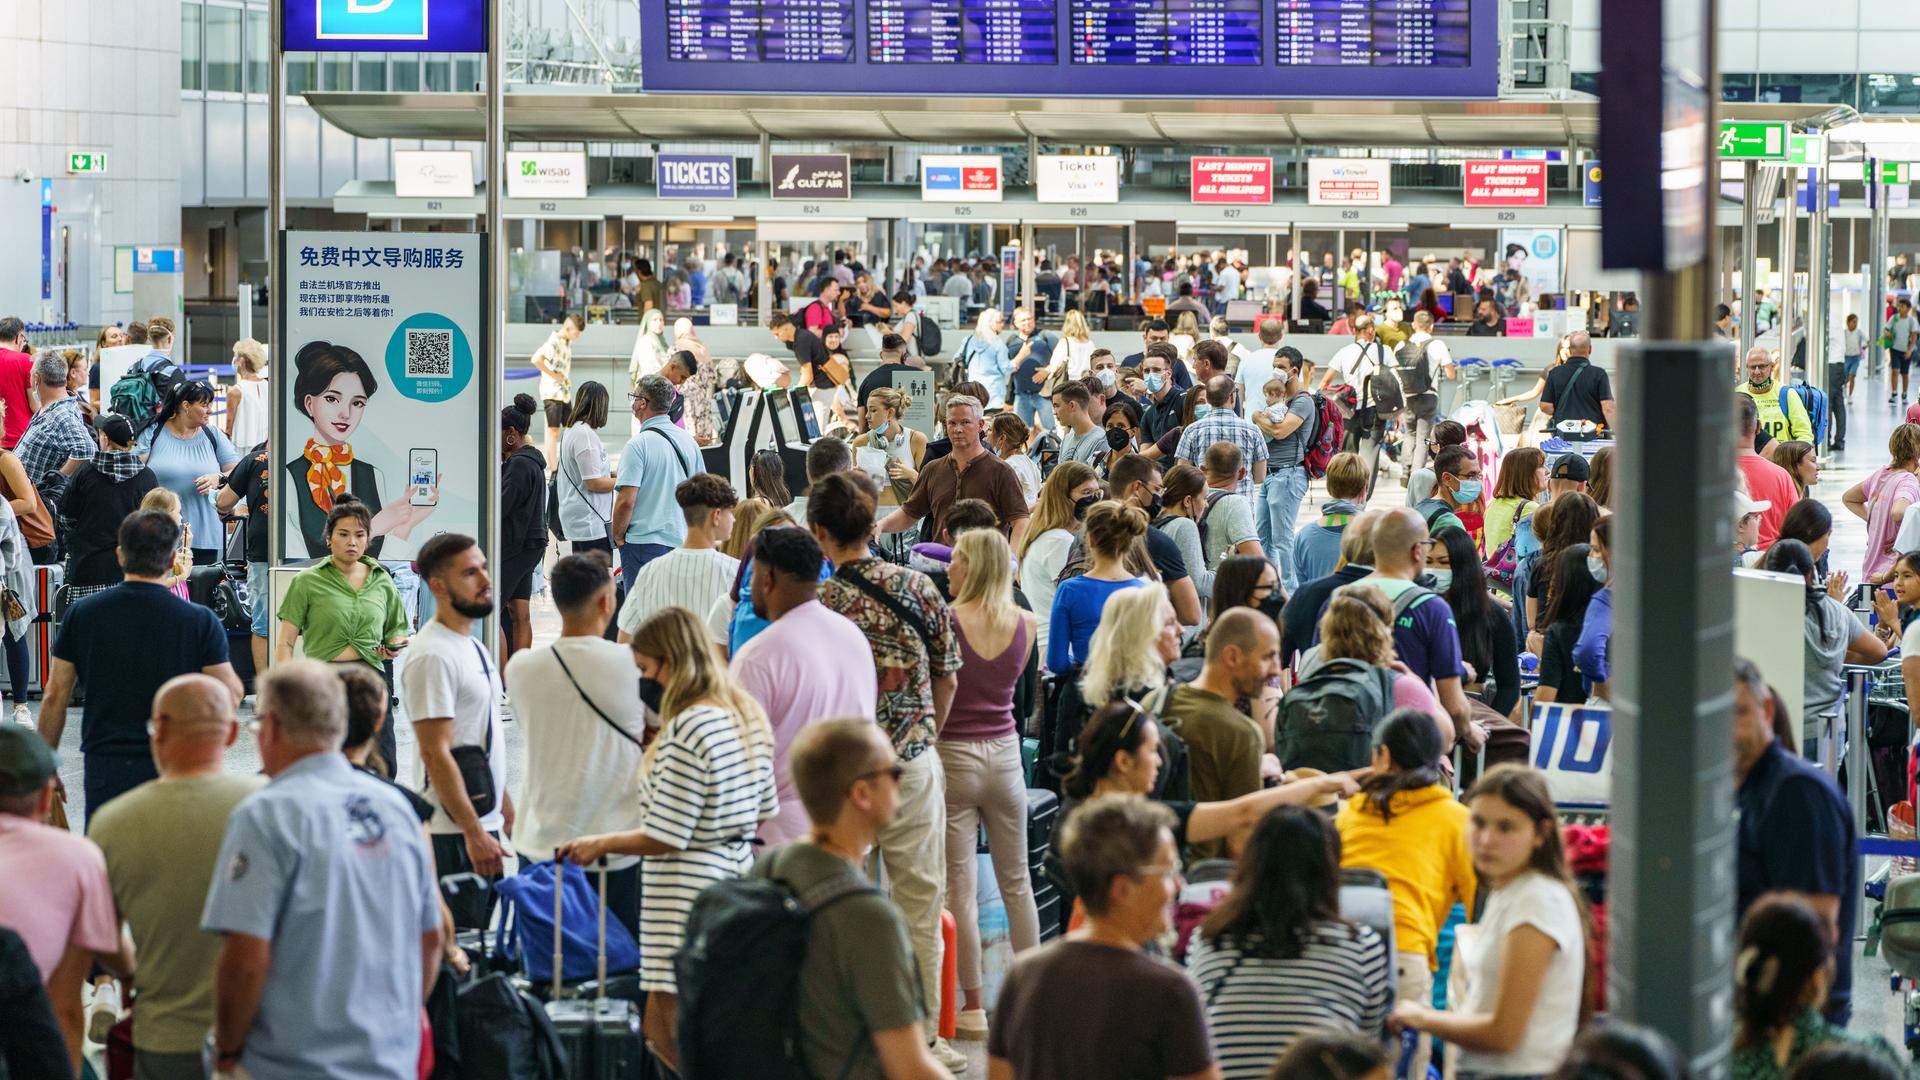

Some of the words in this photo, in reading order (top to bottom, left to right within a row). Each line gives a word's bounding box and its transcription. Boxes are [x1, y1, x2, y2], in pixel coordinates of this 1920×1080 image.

[1058, 161, 1096, 171] Ticket
[1197, 162, 1224, 171] LAST
[1224, 162, 1266, 172] MINUTE
[1471, 165, 1498, 174] LAST
[1497, 165, 1540, 174] MINUTE
[662, 161, 730, 184] TICKETS
[1211, 173, 1253, 183] TICKETS
[1484, 176, 1527, 185] TICKETS
[797, 179, 824, 188] GULF
[826, 179, 843, 188] AIR
[1198, 185, 1217, 194] ALL
[1218, 185, 1266, 195] AIRLINES
[1471, 188, 1490, 197] ALL
[1491, 188, 1540, 197] AIRLINES
[954, 206, 972, 215] 825
[1070, 207, 1087, 216] 826
[1224, 209, 1241, 217] 827
[1342, 210, 1359, 219] 828
[1497, 212, 1516, 220] 829
[299, 246, 465, 269] 免费中文导购服务
[299, 280, 381, 290] 由法兰机场官方推出
[299, 294, 390, 304] 现在预订即享购物乐趣
[299, 307, 394, 317] 我们在安检之后等着你！
